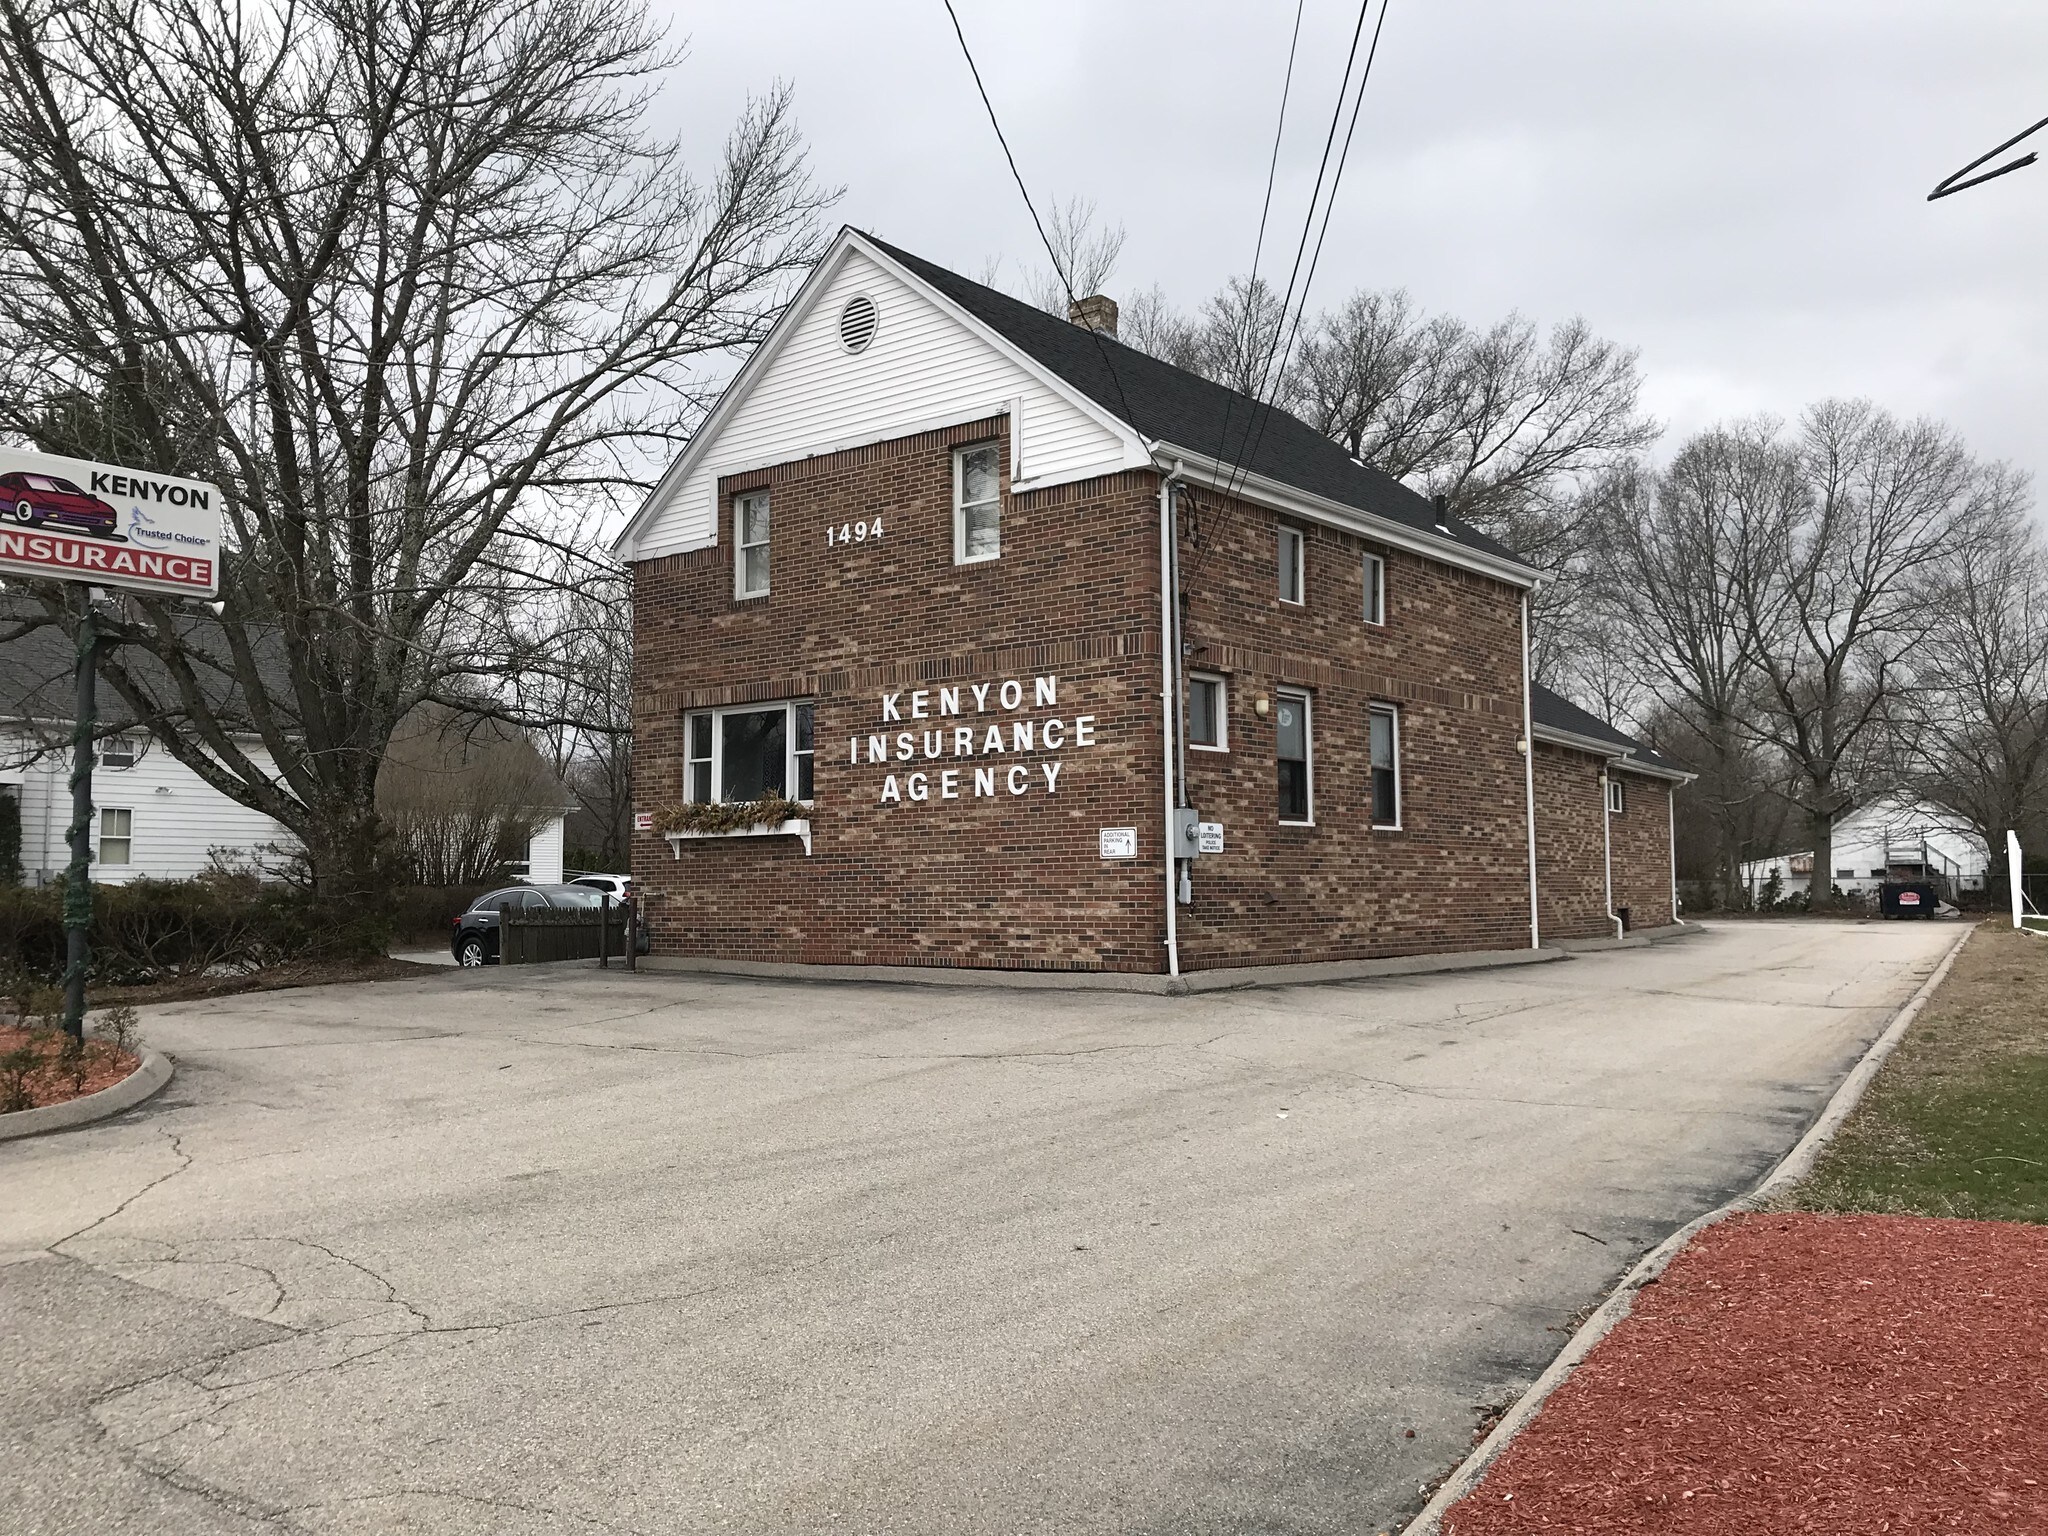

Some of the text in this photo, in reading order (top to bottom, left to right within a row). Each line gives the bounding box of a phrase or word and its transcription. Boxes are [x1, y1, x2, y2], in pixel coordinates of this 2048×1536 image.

[91, 471, 209, 510] KENYON
[136, 527, 206, 545] Trusted Choice
[826, 517, 884, 547] 1494
[0, 533, 209, 582] NSURANCE
[882, 675, 1057, 722] KENYON
[850, 715, 1096, 764] INSURANCE
[880, 762, 1063, 803] AGENCY
